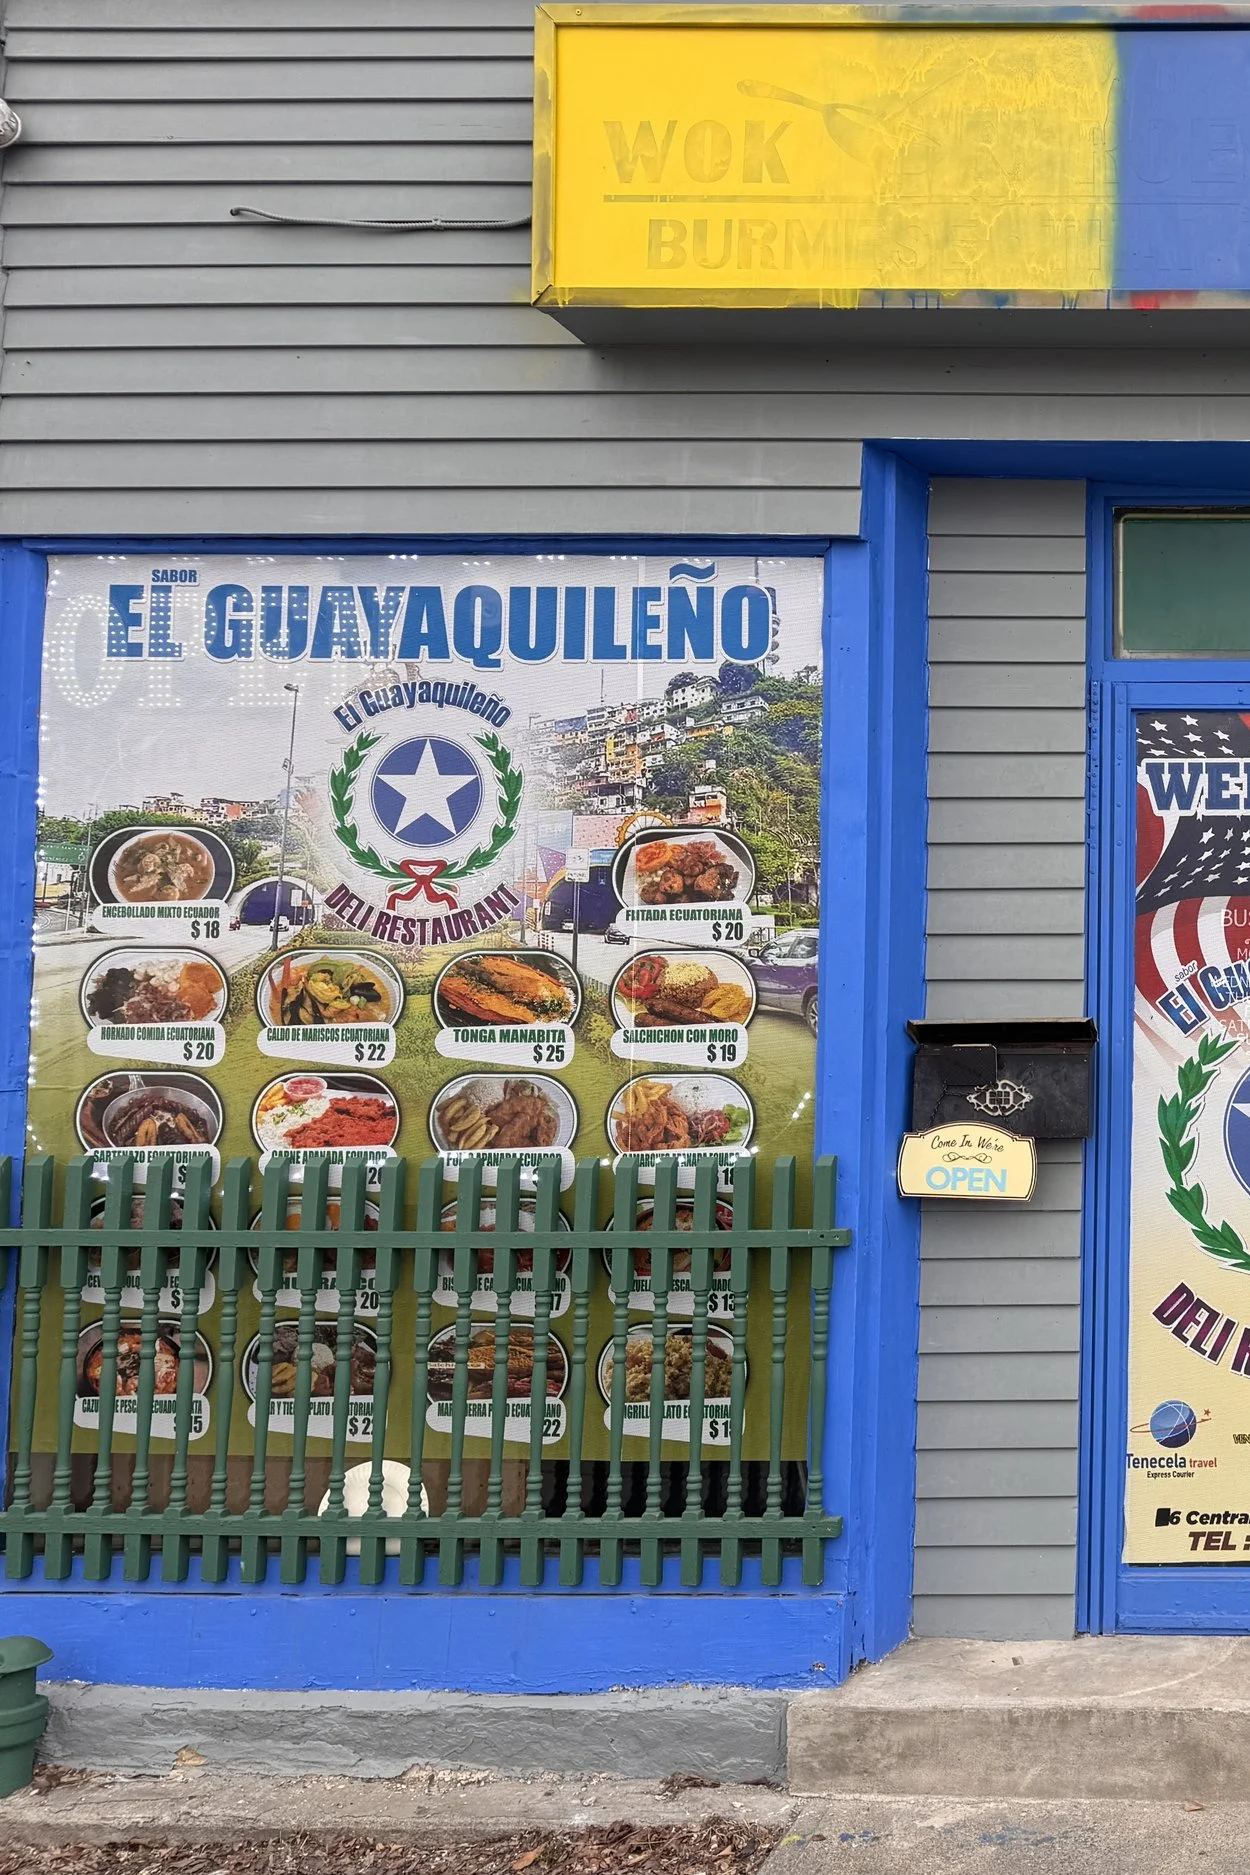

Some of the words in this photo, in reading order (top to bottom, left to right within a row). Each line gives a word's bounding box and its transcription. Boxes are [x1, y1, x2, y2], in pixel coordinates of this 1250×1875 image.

[603, 120, 792, 184] WOK
[152, 570, 197, 583] SABOR
[107, 585, 183, 659] EL
[204, 563, 772, 668] GUAYAQUILEÑO
[333, 701, 363, 733] El
[358, 680, 512, 728] Guayaquileño
[102, 906, 156, 919] ENCEBOLLADO
[157, 906, 182, 919] MIXTO
[183, 906, 220, 919] ECUADOR
[324, 882, 376, 931] DELI
[371, 882, 520, 945] RESTAURANT
[670, 909, 743, 921] ECUATORIANA
[202, 921, 220, 939] 18
[725, 922, 743, 940] 20
[1174, 961, 1198, 982] sabor
[1158, 984, 1209, 1036] El
[137, 1027, 166, 1041] COMIDA
[167, 1027, 215, 1041] ECUATORIANA
[267, 1028, 287, 1042] CALDO
[289, 1028, 300, 1042] DE
[301, 1028, 339, 1042] MARISCOS
[340, 1028, 389, 1042] ECUATORIANA
[453, 1029, 496, 1043] TONGA
[499, 1029, 566, 1043] MANABITA
[623, 1029, 684, 1043] SALCHICHON
[686, 1029, 707, 1043] CON
[708, 1029, 738, 1043] MORO
[196, 1043, 214, 1060] 20
[368, 1044, 385, 1061] 22
[546, 1045, 565, 1062] 25
[719, 1045, 736, 1062] 19
[931, 1135, 957, 1150] Come
[960, 1134, 973, 1148] In
[977, 1137, 1005, 1152] We're
[926, 1166, 1007, 1192] OPEN
[1152, 1282, 1237, 1363] DELI
[1126, 1453, 1186, 1468] Tenecela
[1189, 1457, 1217, 1468] travel
[1147, 1471, 1171, 1480] Express
[1188, 1531, 1236, 1551] TEL
